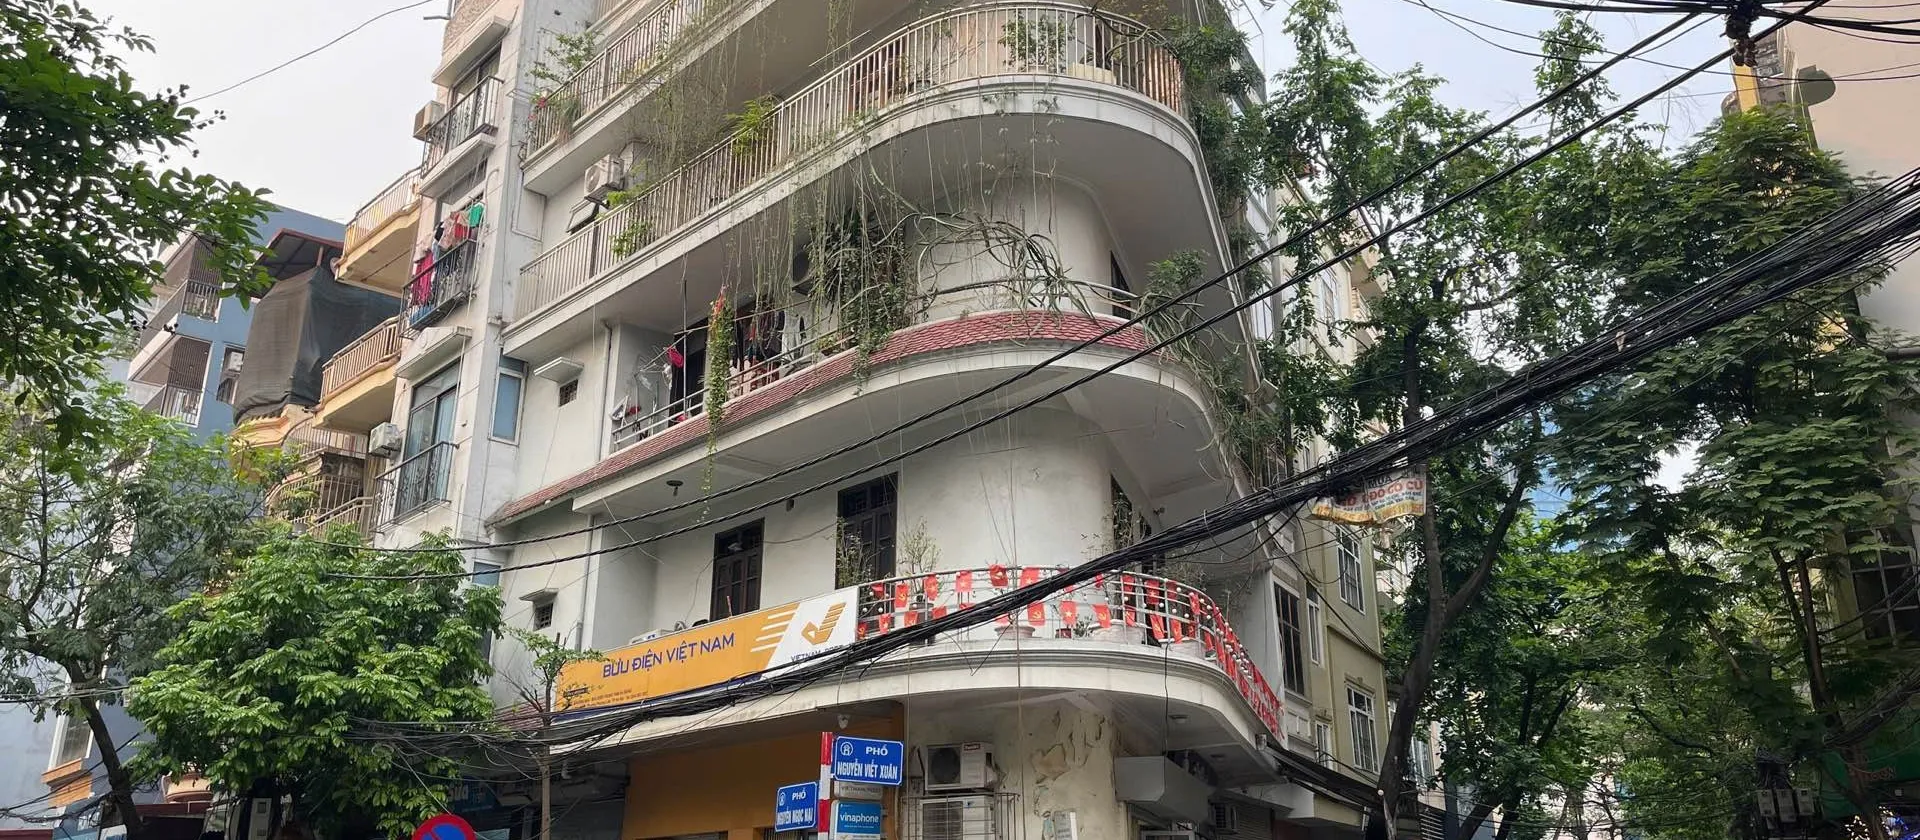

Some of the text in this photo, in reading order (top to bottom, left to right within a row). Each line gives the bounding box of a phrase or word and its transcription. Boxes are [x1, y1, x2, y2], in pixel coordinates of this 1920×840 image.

[603, 632, 735, 678] BƯU ĐIỆN VIỆT NAM
[865, 744, 888, 756] PHỐ
[837, 759, 898, 780] NGUYỄN VIẾT XUÂN
[792, 787, 806, 800] PHỐ
[840, 811, 879, 823] vinaphone
